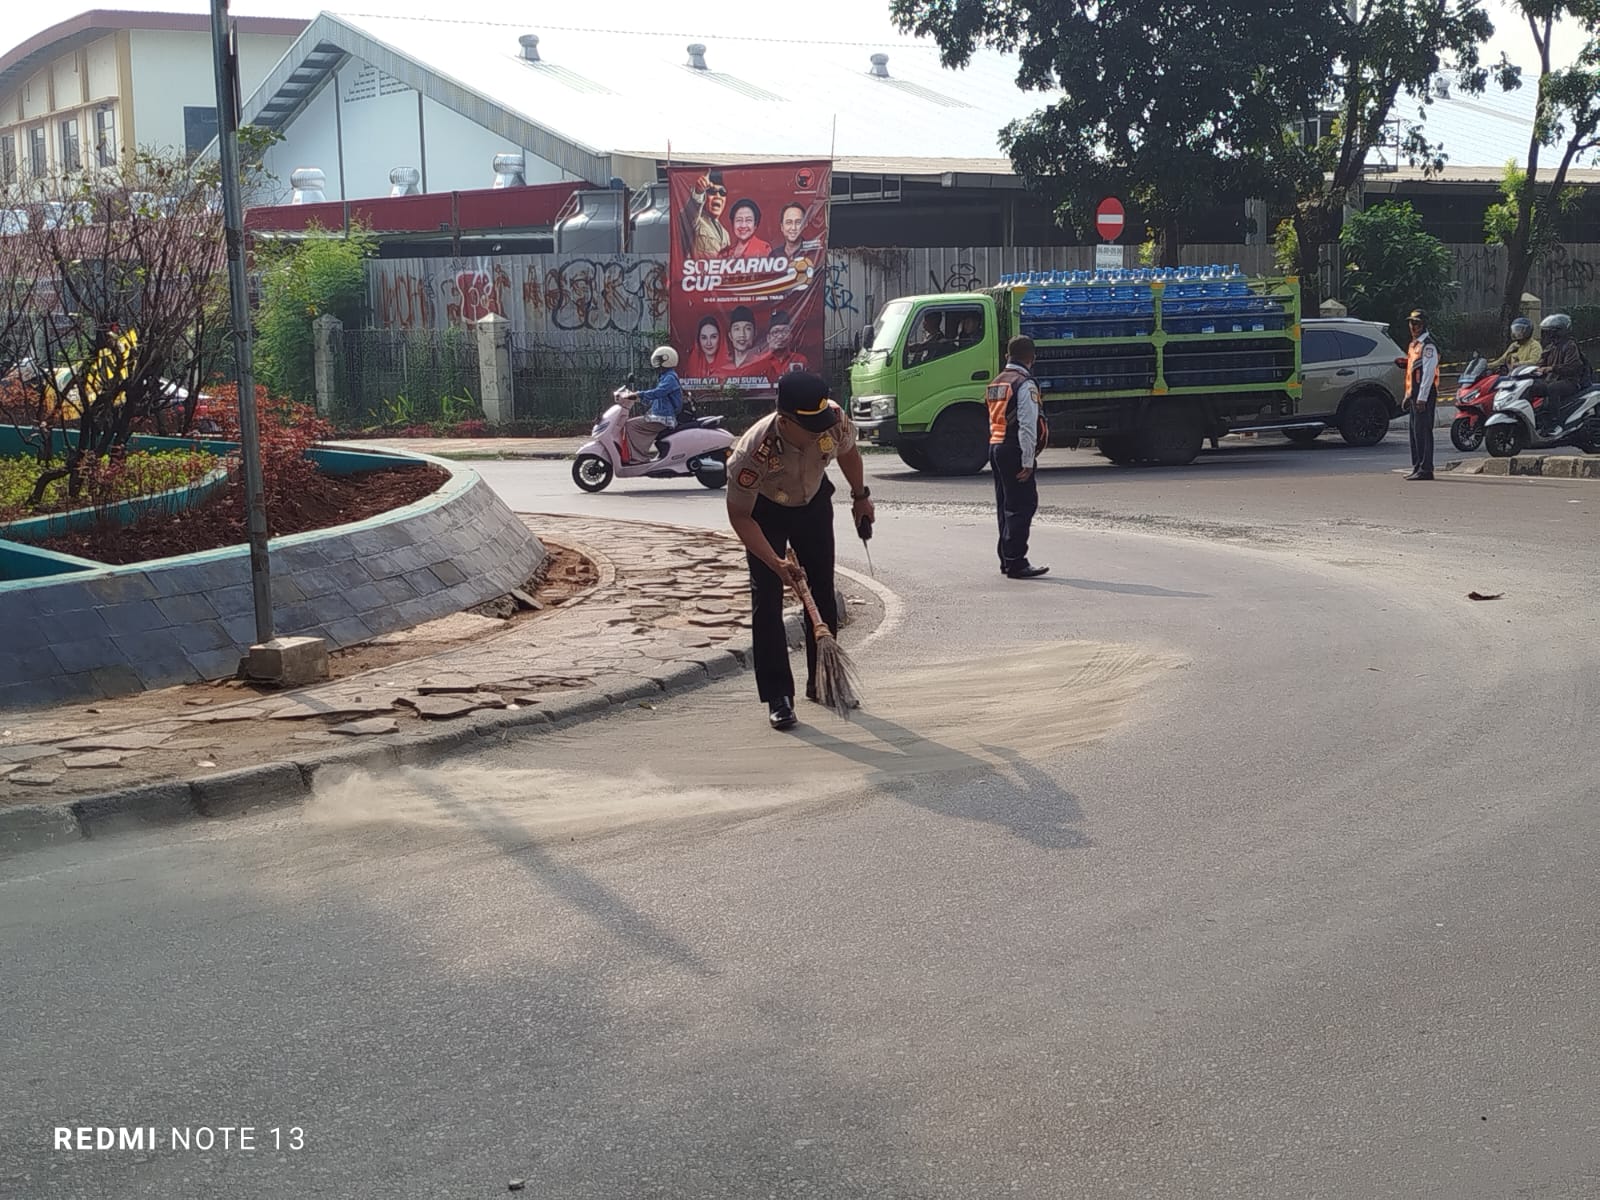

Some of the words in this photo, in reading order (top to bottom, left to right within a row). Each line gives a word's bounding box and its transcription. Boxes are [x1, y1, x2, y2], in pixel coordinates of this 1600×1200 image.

[682, 257, 788, 275] SOEKARNO
[682, 275, 722, 292] CUP
[726, 376, 740, 385] ADI
[741, 376, 769, 385] SURYA
